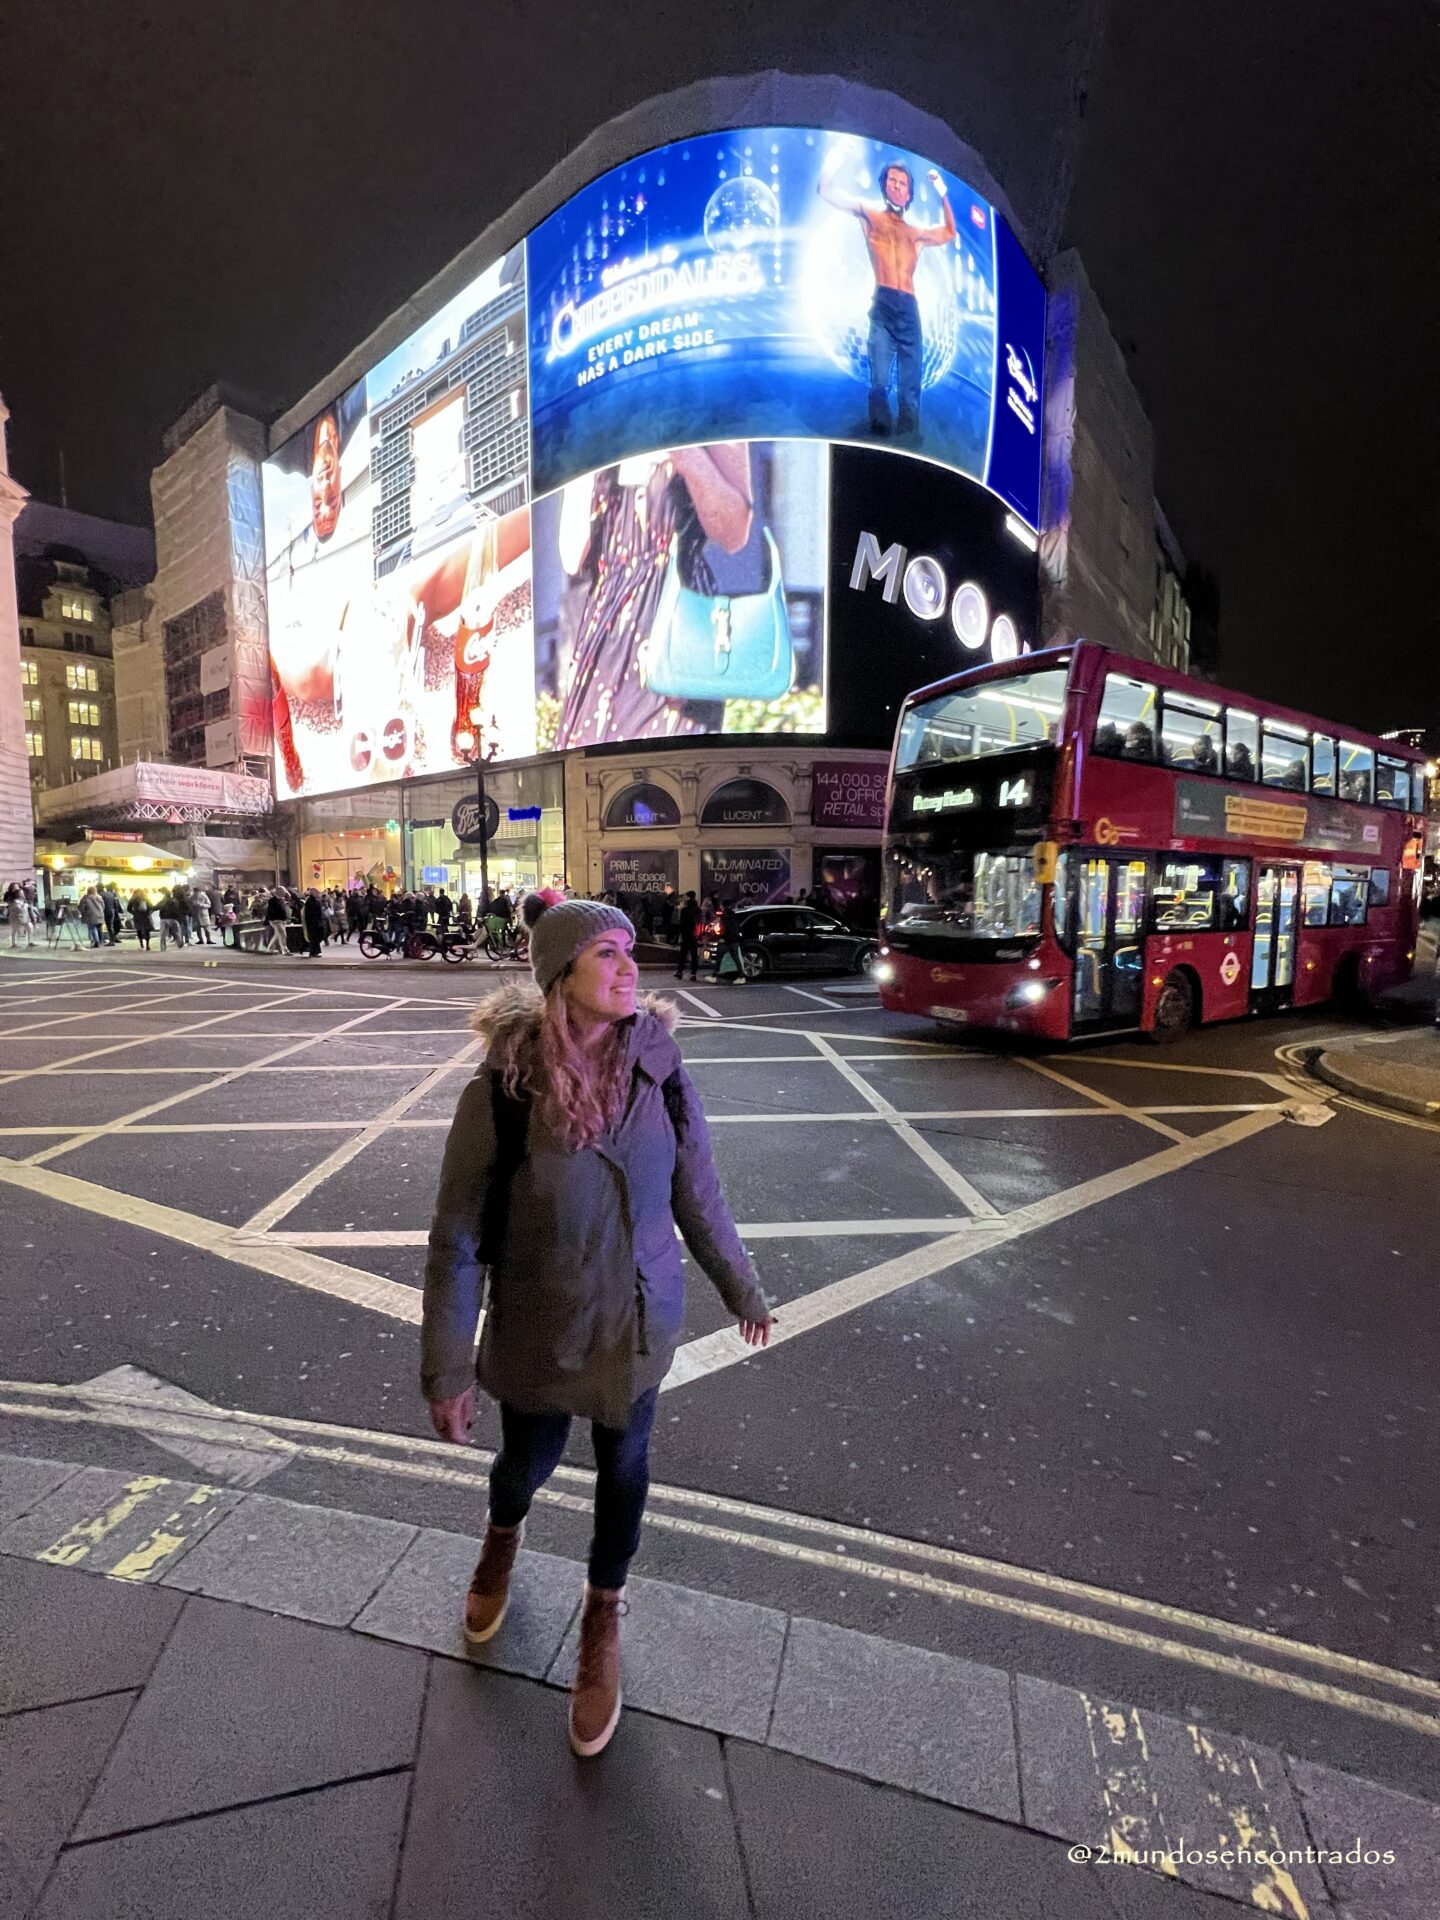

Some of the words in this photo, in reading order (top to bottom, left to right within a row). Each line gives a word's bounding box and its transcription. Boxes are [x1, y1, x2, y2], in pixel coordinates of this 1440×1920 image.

[588, 330, 633, 363] EVERY
[638, 312, 699, 340] DREAM
[577, 361, 604, 387] HAS
[608, 356, 619, 371] A
[623, 339, 667, 365] DARK
[673, 329, 715, 351] SIDE
[156, 777, 176, 787] their
[178, 779, 221, 793] workforce
[815, 773, 870, 788] 144,000
[830, 785, 843, 801] of
[846, 788, 885, 803] OFFIC
[999, 779, 1028, 807] 14
[723, 810, 762, 820] LUCENT
[823, 802, 867, 817] RETAIL
[625, 814, 659, 824] LUCENT
[609, 860, 639, 871] PRIME
[708, 859, 783, 871] ILLUMINATED
[615, 872, 636, 882] retail
[638, 873, 666, 885] space
[714, 872, 726, 884] by
[730, 873, 743, 881] an
[620, 882, 671, 893] AVAILABLE
[739, 882, 769, 893] ICON
